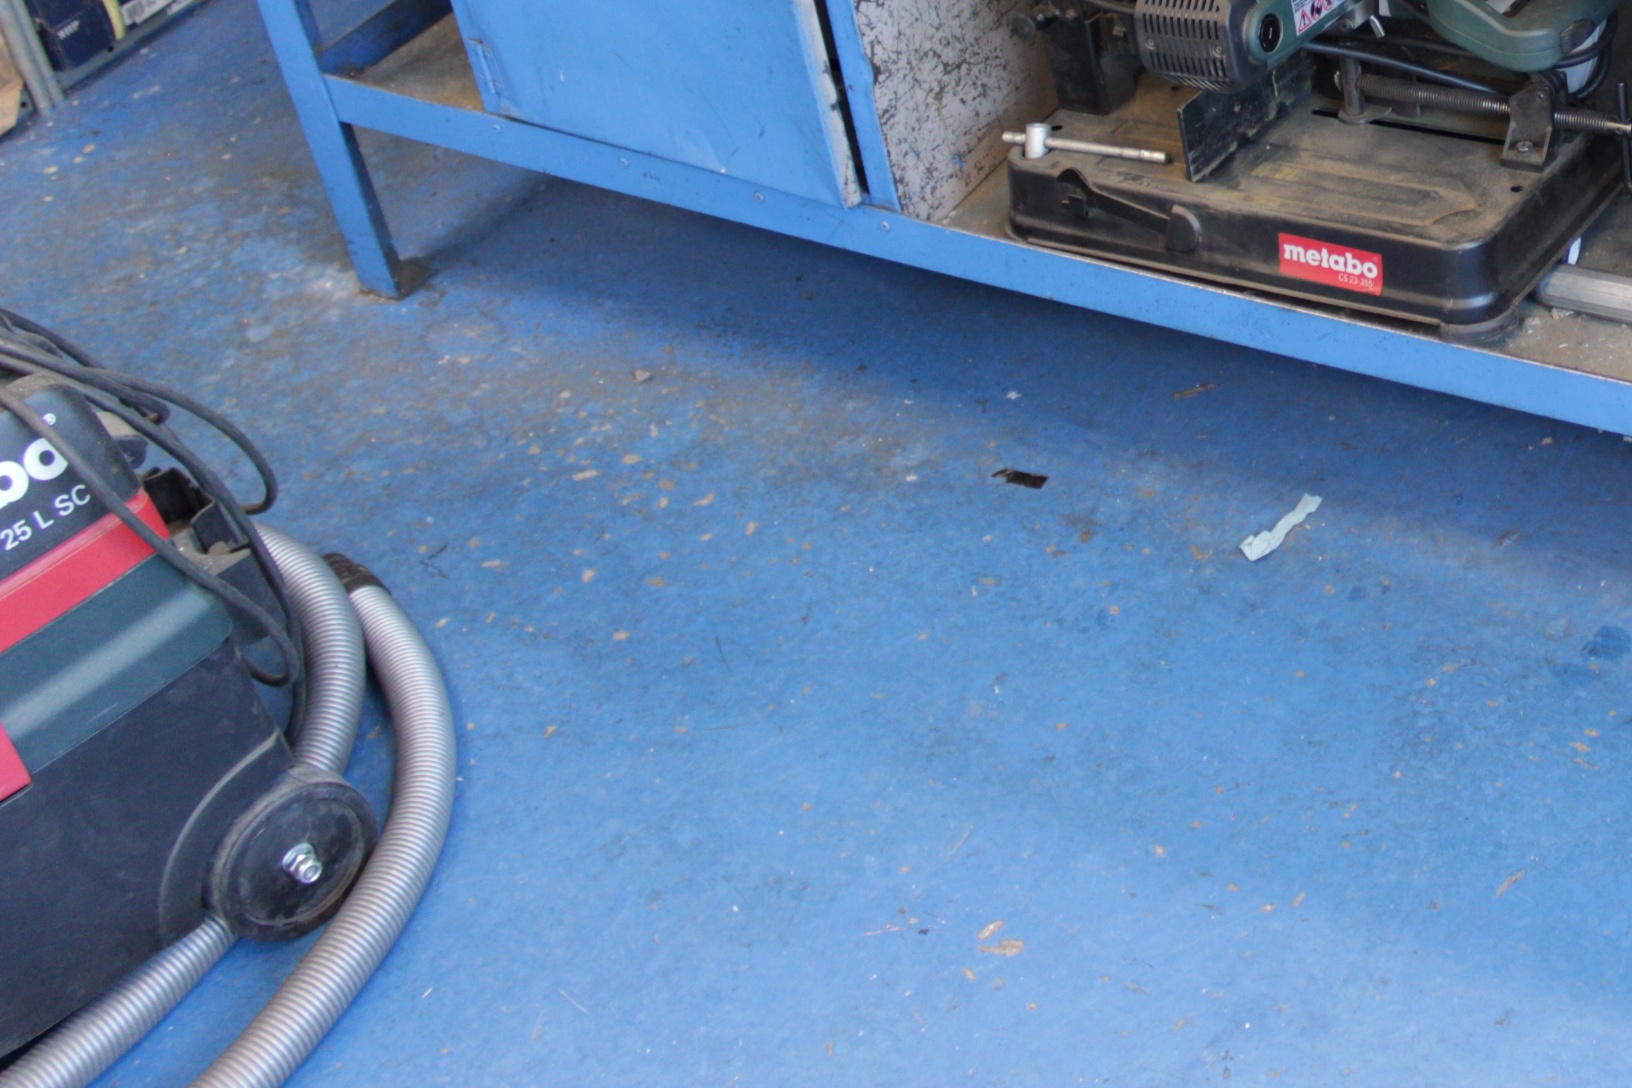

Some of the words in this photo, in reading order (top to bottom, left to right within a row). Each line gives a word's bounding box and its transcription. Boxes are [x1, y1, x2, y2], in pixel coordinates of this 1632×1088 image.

[1283, 243, 1379, 279] metabo
[1338, 273, 1349, 283] CS
[0, 520, 32, 551] 25
[33, 511, 54, 529] L
[54, 484, 91, 516] SC
